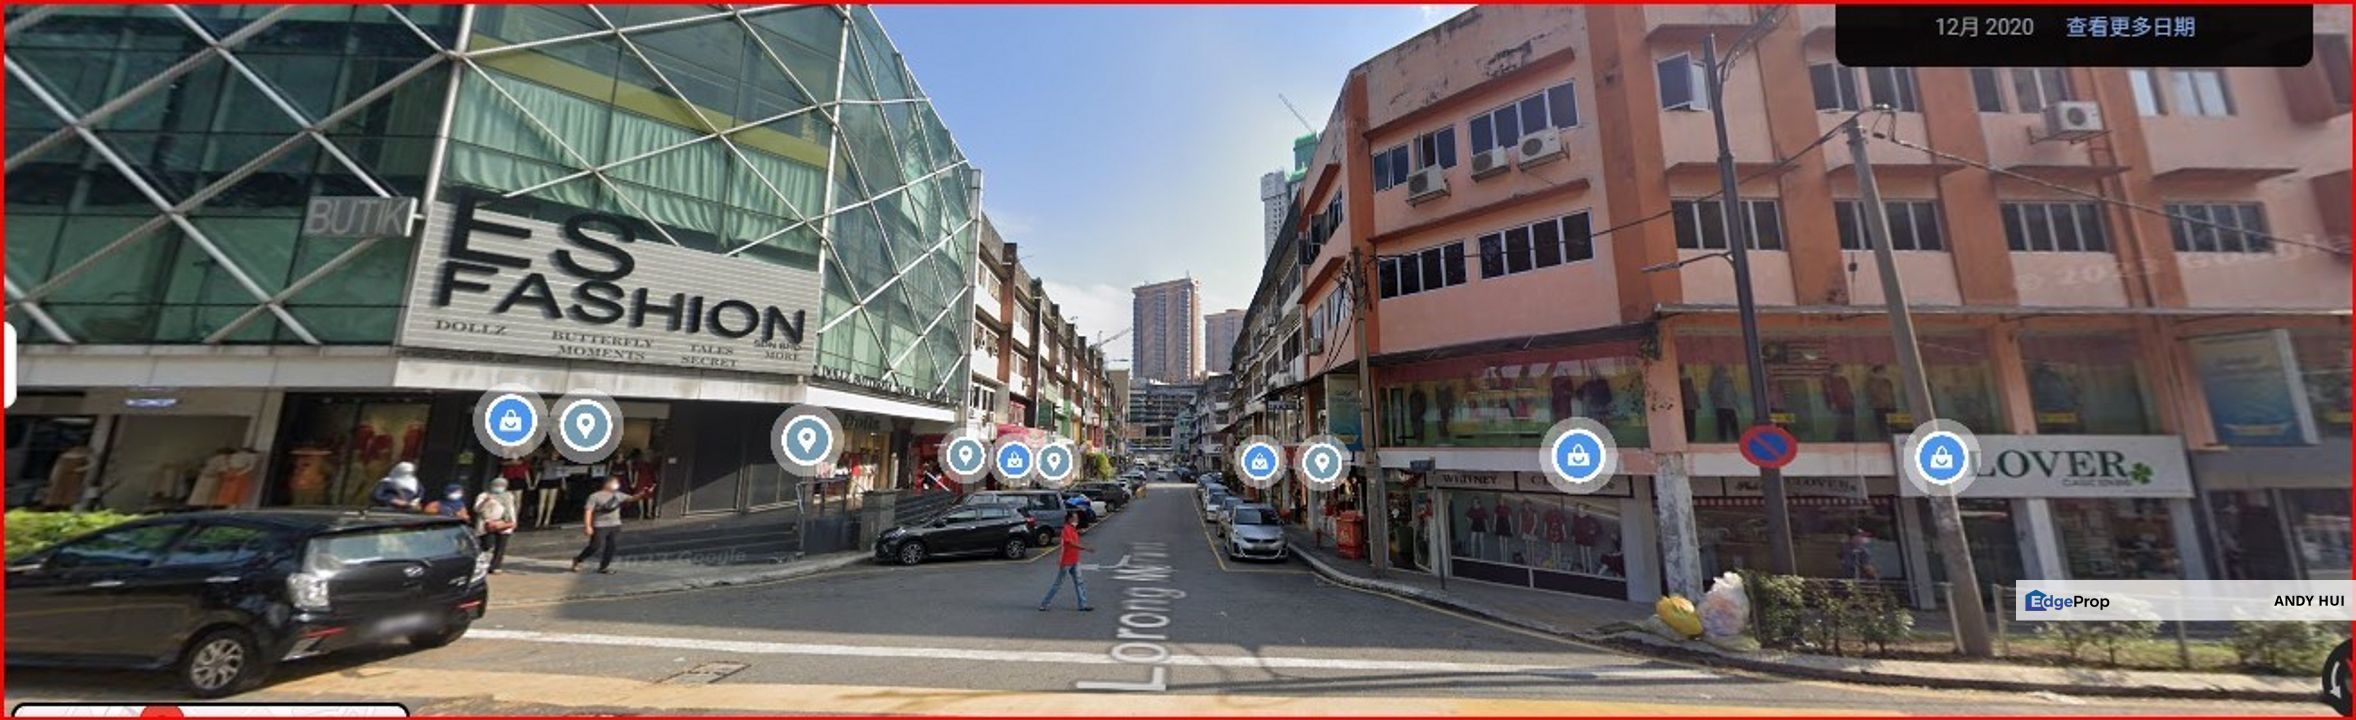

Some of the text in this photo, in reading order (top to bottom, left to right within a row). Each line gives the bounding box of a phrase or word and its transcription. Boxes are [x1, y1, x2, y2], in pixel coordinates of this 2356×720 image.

[306, 199, 408, 234] BUTIK
[447, 190, 637, 283] ES
[432, 259, 806, 345] FASHION
[435, 319, 508, 336] DOLLZ
[551, 330, 656, 350] BUTTERFLY
[556, 345, 648, 363] MOMENTS
[689, 344, 735, 356] TALES
[763, 350, 801, 362] MORE
[680, 355, 740, 368] SECRET
[1966, 449, 2128, 478] LOVER
